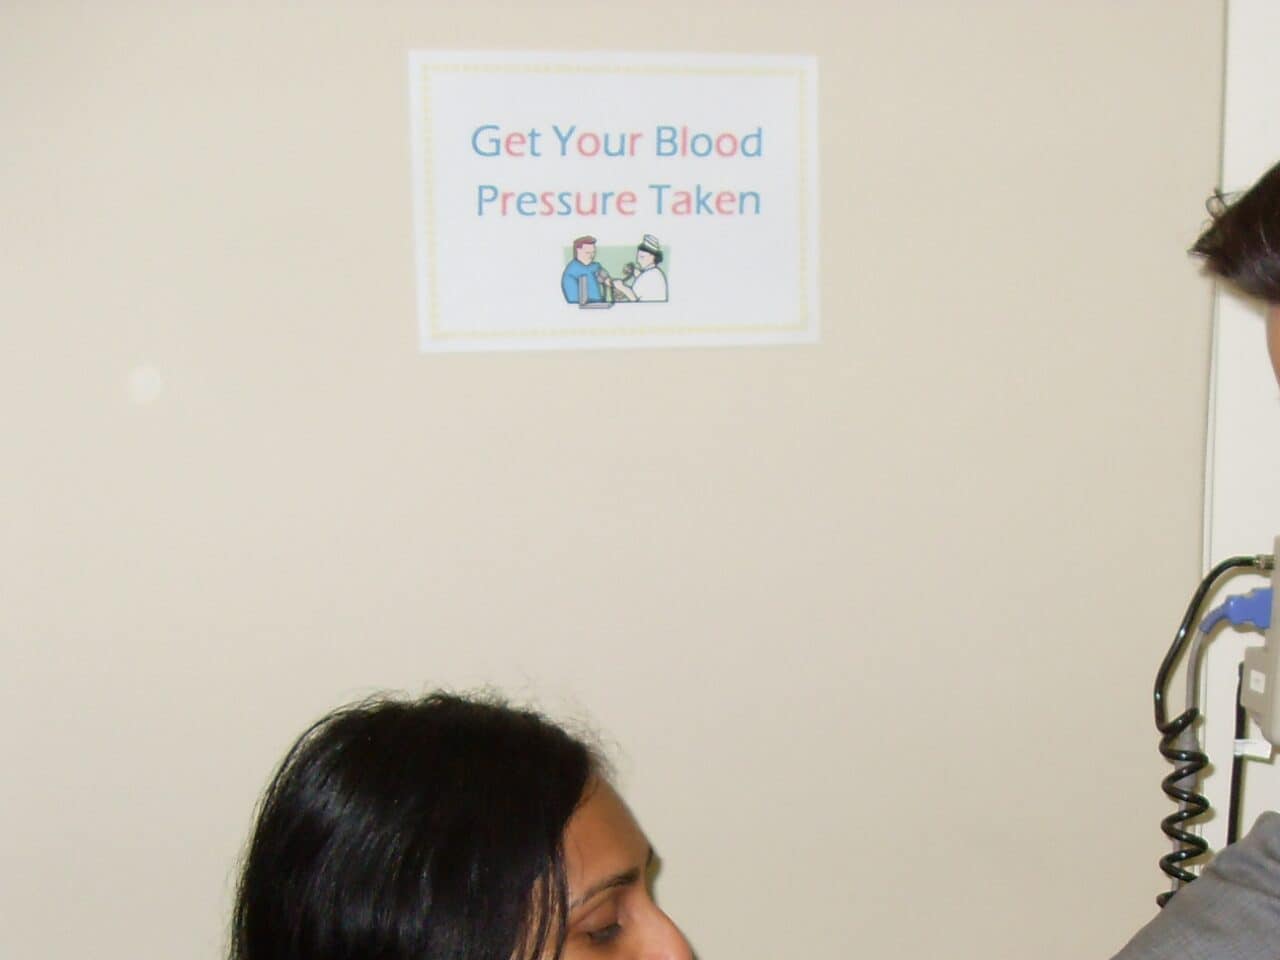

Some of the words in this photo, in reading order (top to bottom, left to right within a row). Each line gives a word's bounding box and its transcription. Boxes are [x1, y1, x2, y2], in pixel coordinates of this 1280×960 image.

[471, 124, 542, 157] Get
[553, 124, 643, 157] Your
[655, 125, 763, 158] Blood
[476, 184, 637, 216] Pressure
[649, 184, 761, 215] Taken
